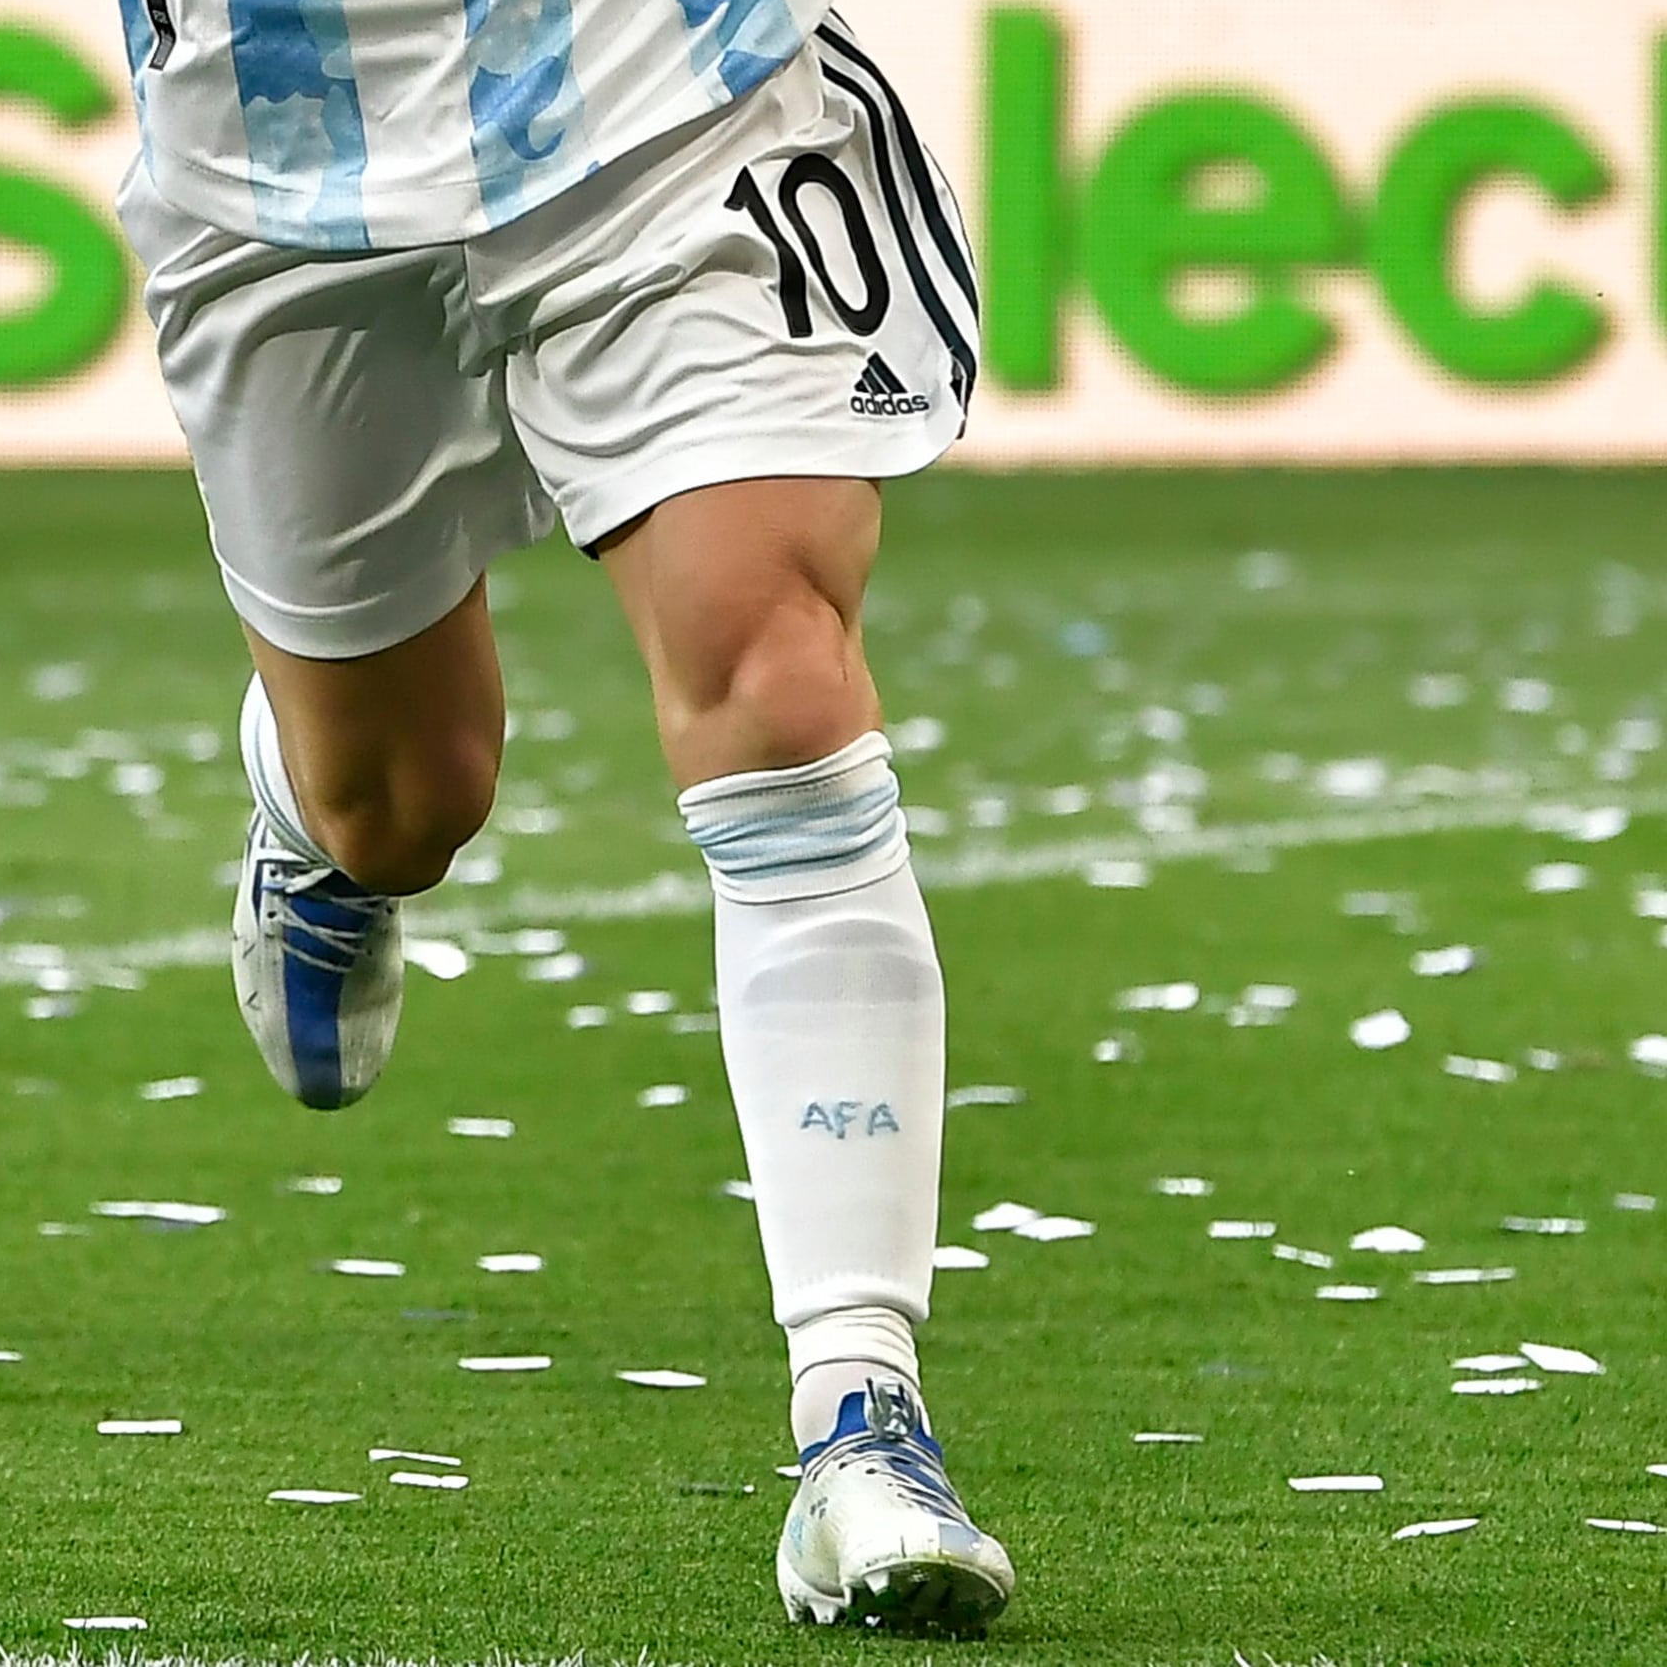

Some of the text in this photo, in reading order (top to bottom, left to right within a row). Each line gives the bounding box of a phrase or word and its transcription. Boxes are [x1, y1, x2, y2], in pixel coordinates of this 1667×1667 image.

[723, 152, 891, 339] 10
[850, 389, 929, 416] adidas
[800, 1100, 900, 1139] AFA
